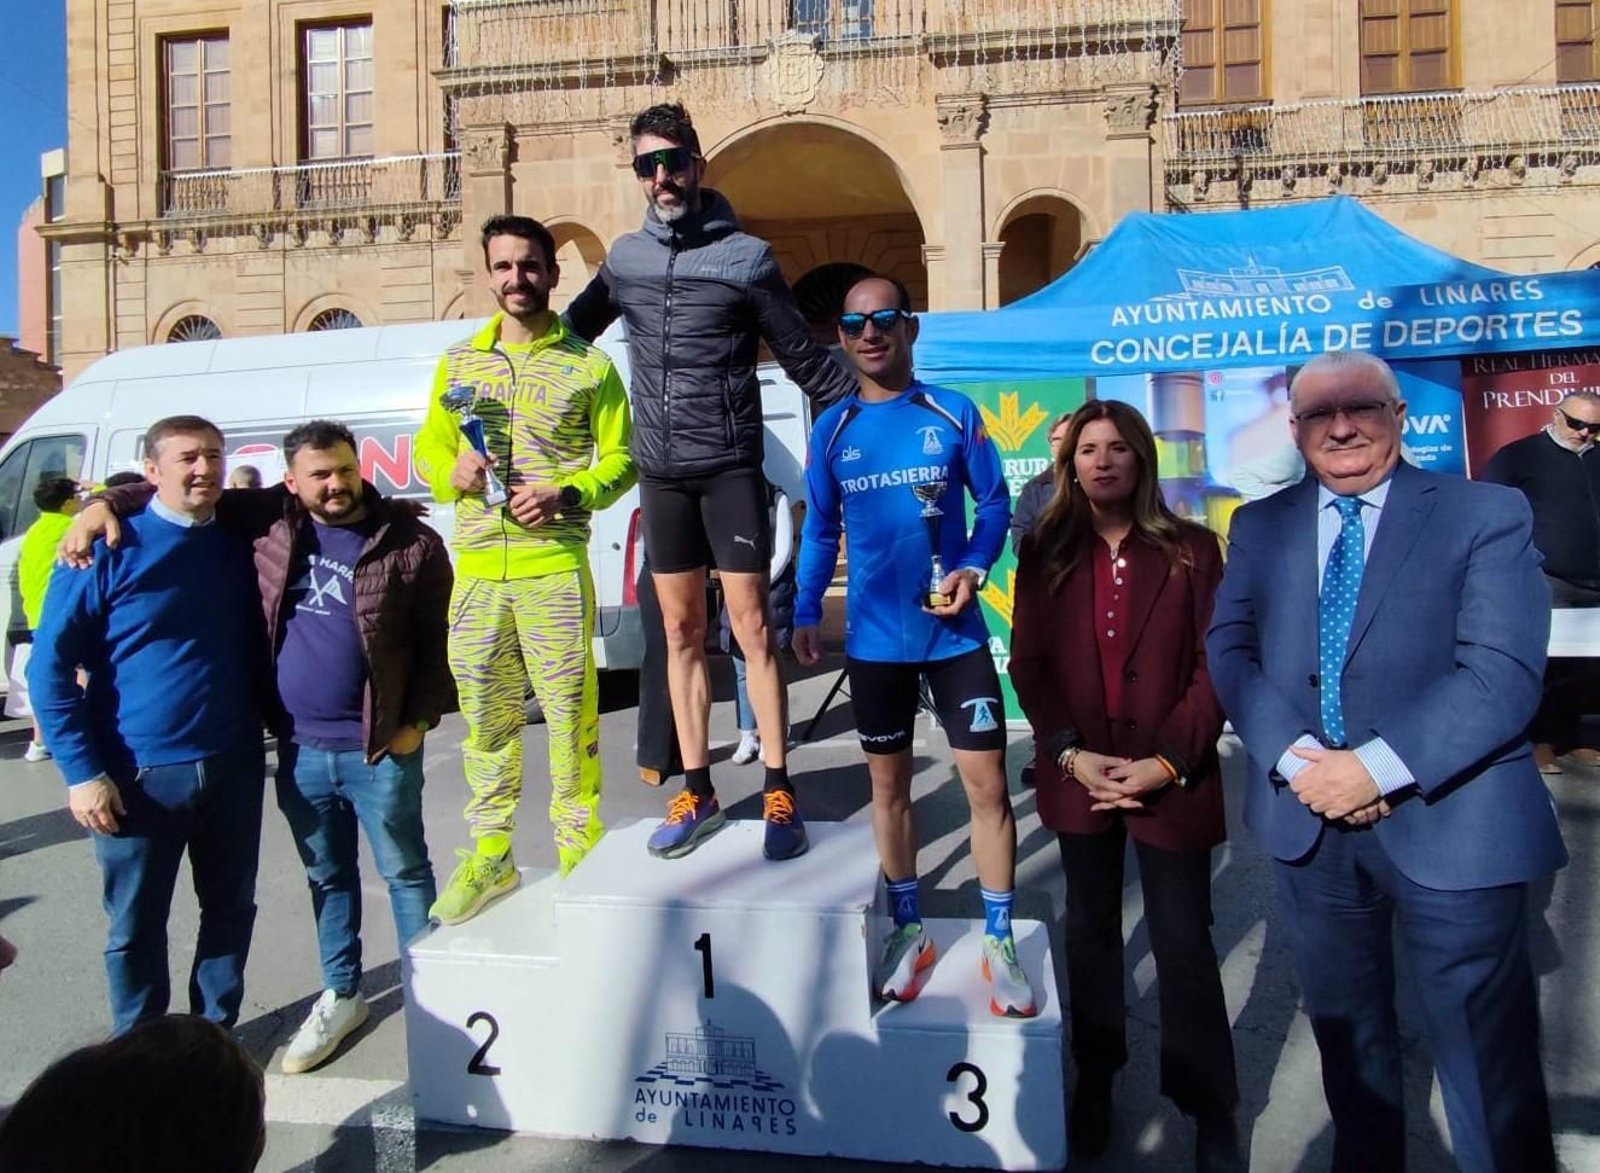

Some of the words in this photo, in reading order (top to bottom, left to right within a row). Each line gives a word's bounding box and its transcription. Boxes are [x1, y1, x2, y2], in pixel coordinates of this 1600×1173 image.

[1111, 293, 1332, 327] AYUNTAMIENTO
[1357, 290, 1394, 310] de
[1419, 279, 1544, 307] LINARES
[1090, 320, 1313, 365] CONCEJALÍA
[1323, 322, 1373, 352] DE
[1383, 309, 1584, 348] DEPORTES
[1549, 371, 1580, 385] DEL
[840, 465, 949, 494] TROTASIERRA
[693, 932, 715, 999] 1
[465, 1010, 502, 1077] 2
[634, 1087, 797, 1117] AYUNTAMIENTO
[634, 1107, 658, 1123] de
[945, 1061, 990, 1133] 3
